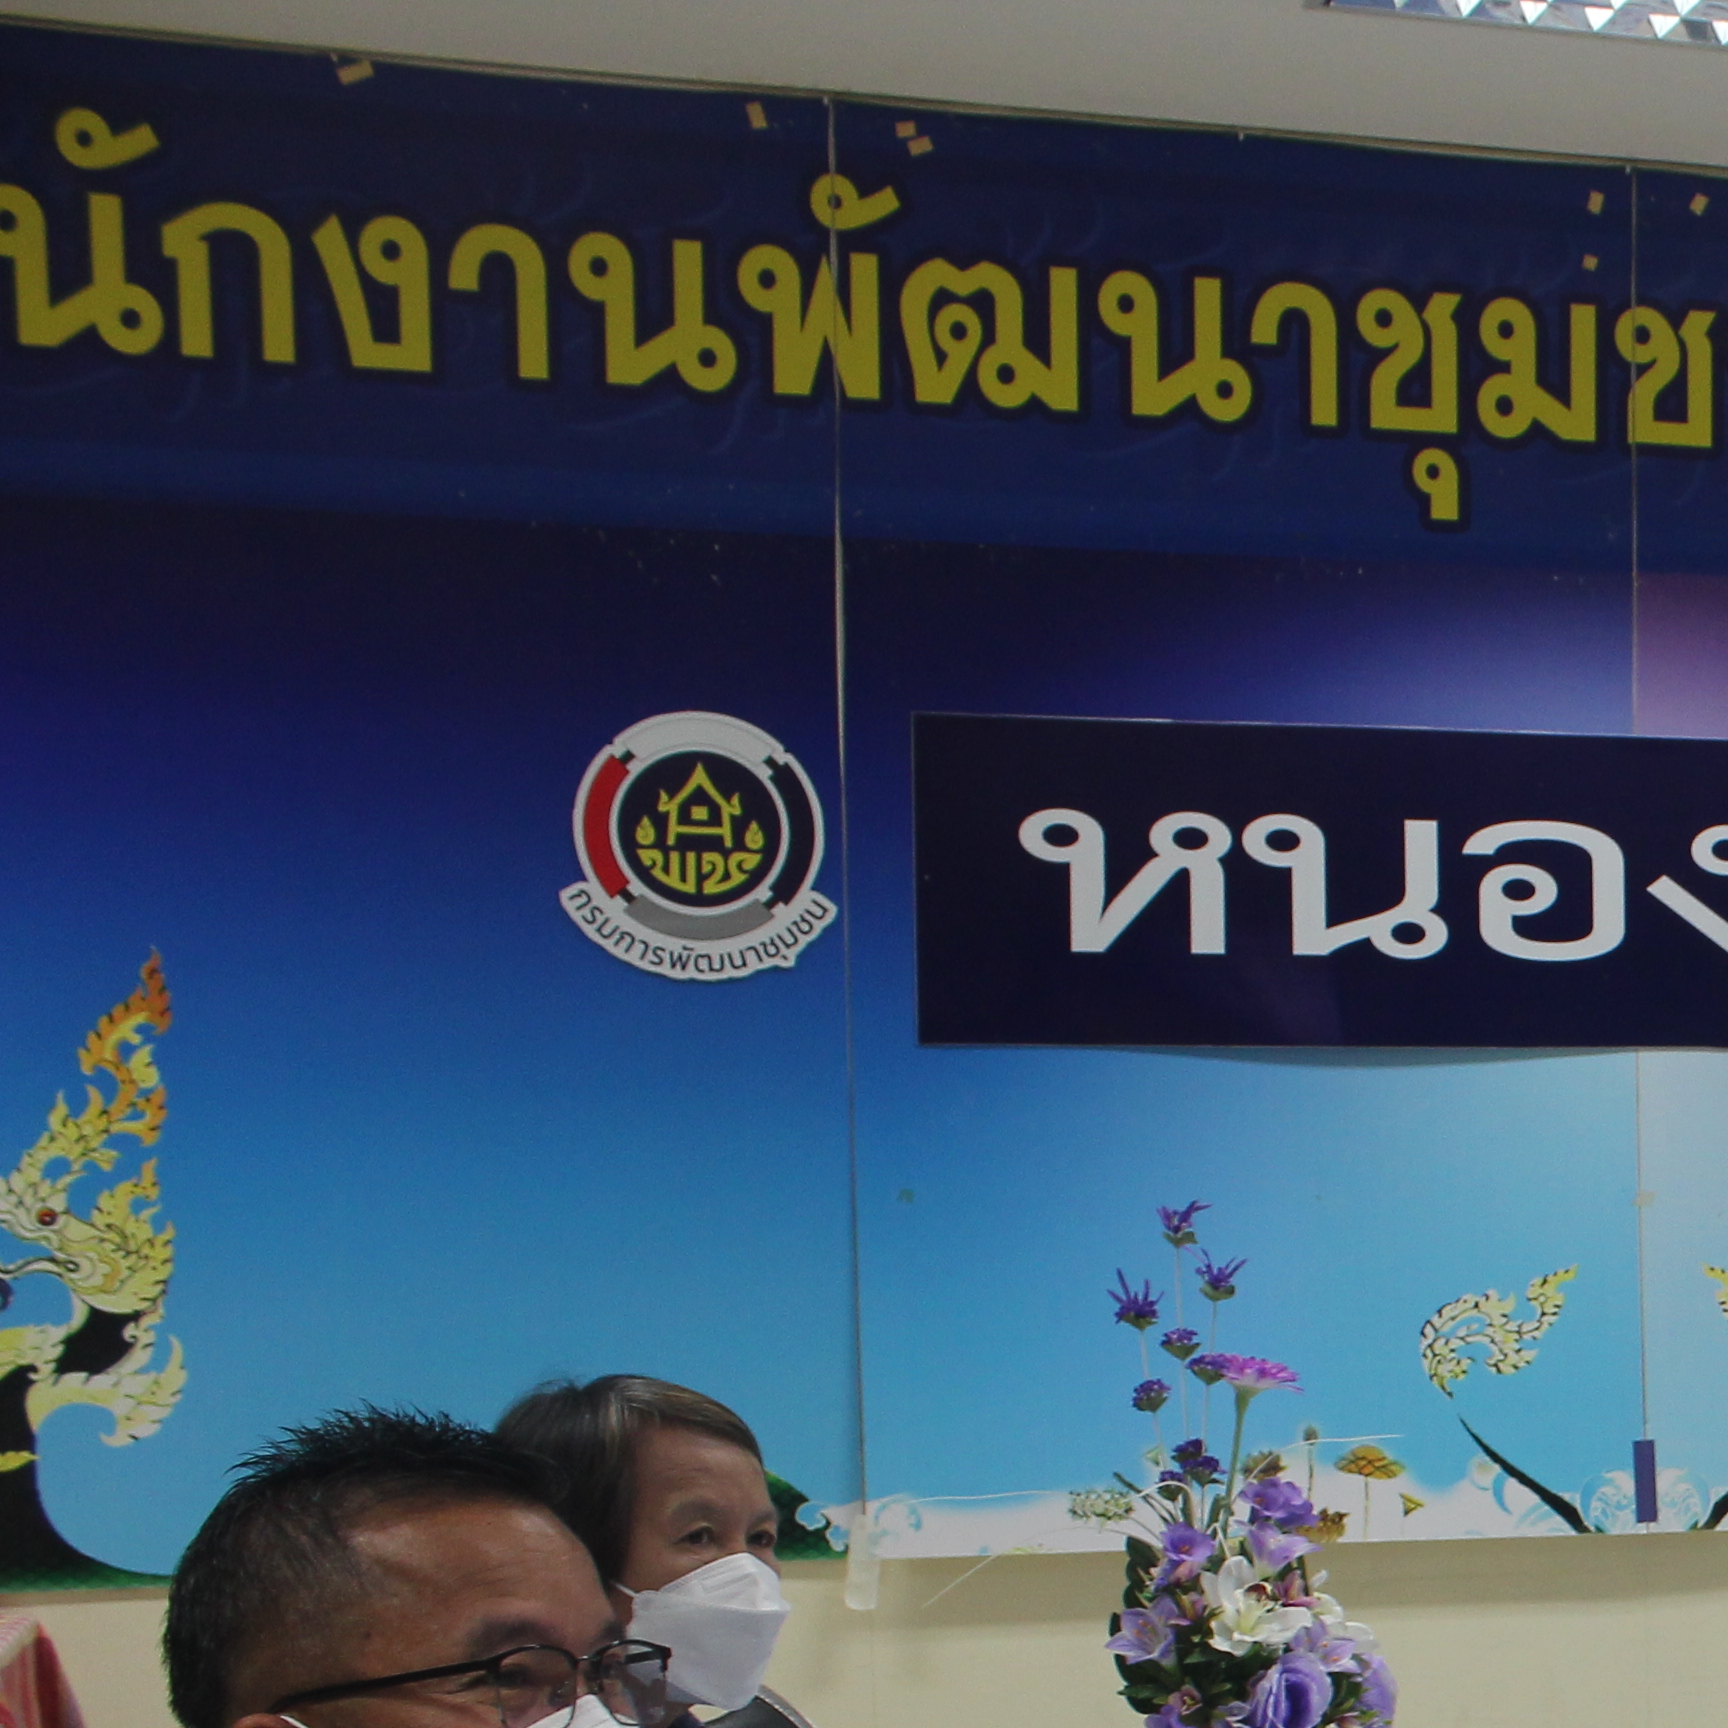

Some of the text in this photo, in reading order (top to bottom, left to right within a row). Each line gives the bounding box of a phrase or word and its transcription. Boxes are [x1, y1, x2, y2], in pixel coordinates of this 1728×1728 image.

[566, 886, 829, 975] กรมการพัฒนาชุมชน
